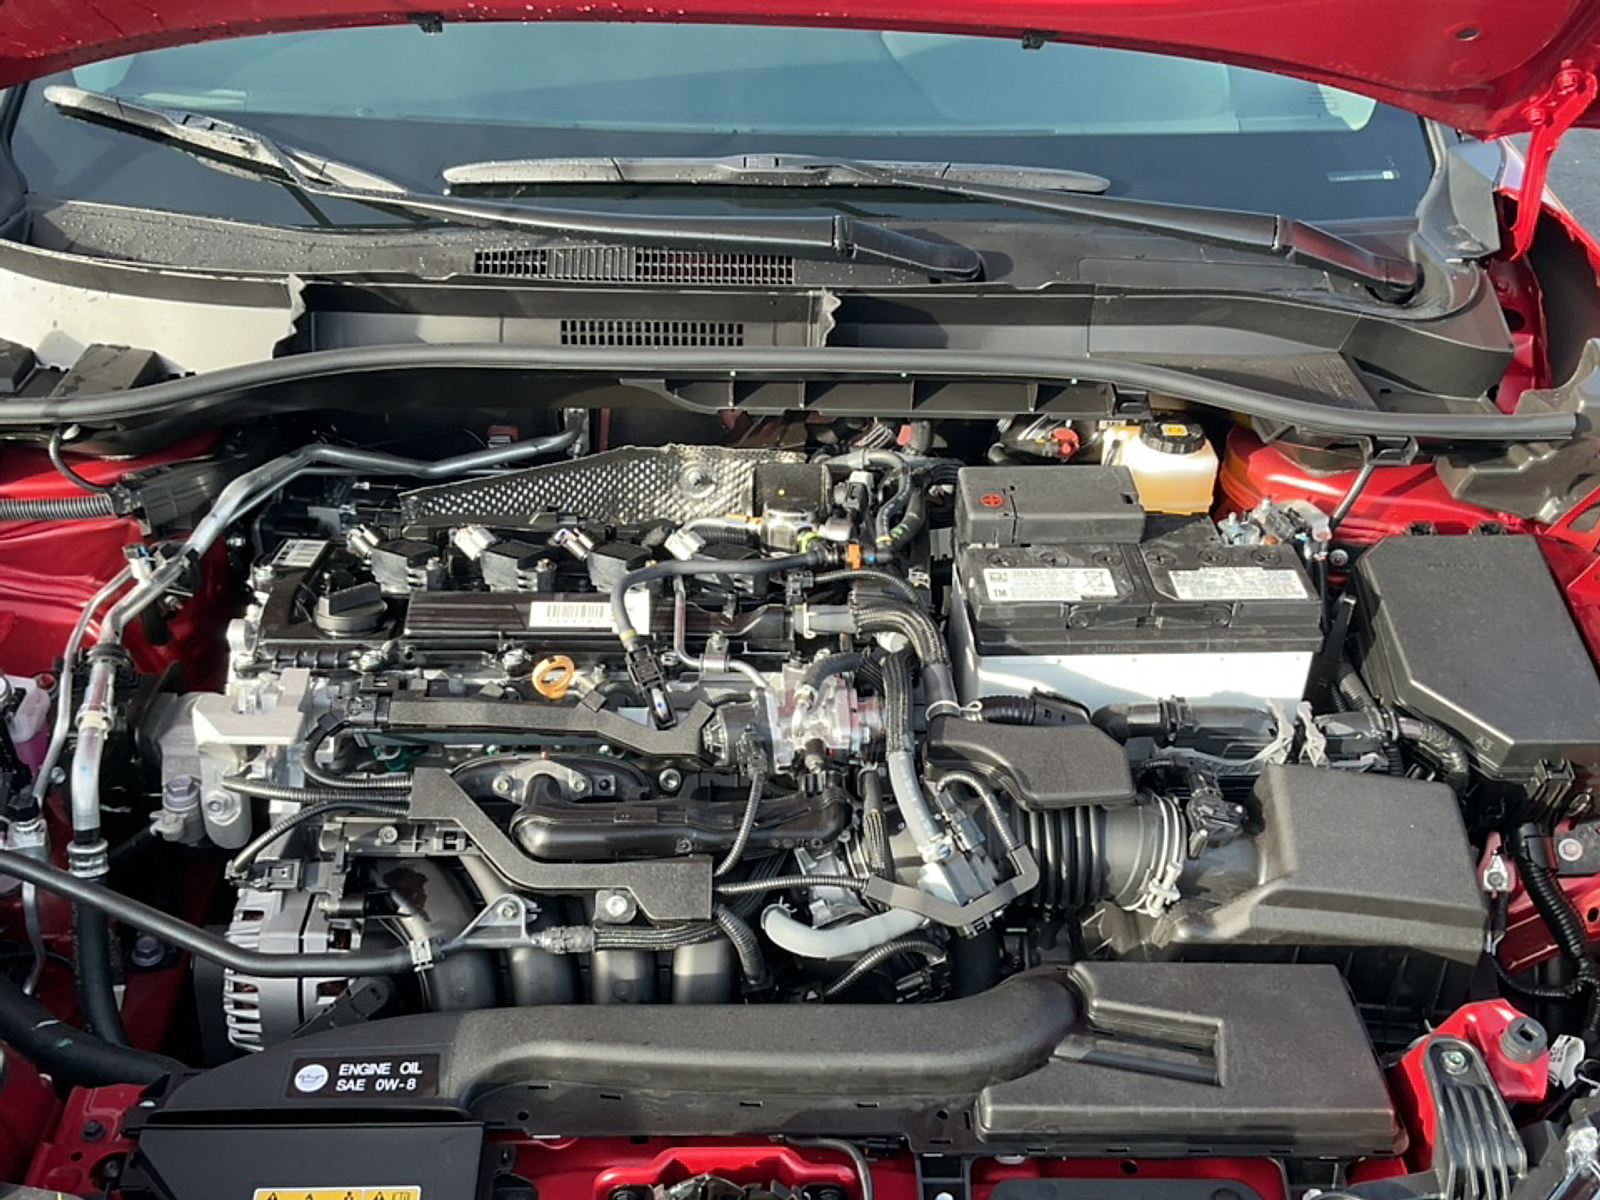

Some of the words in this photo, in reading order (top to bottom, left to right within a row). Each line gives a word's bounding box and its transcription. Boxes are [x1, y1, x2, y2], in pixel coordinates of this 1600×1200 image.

[338, 1062, 392, 1076] ENGINE
[399, 1061, 423, 1075] OIL
[335, 1078, 367, 1092] SAE
[375, 1078, 417, 1092] 0W-8
